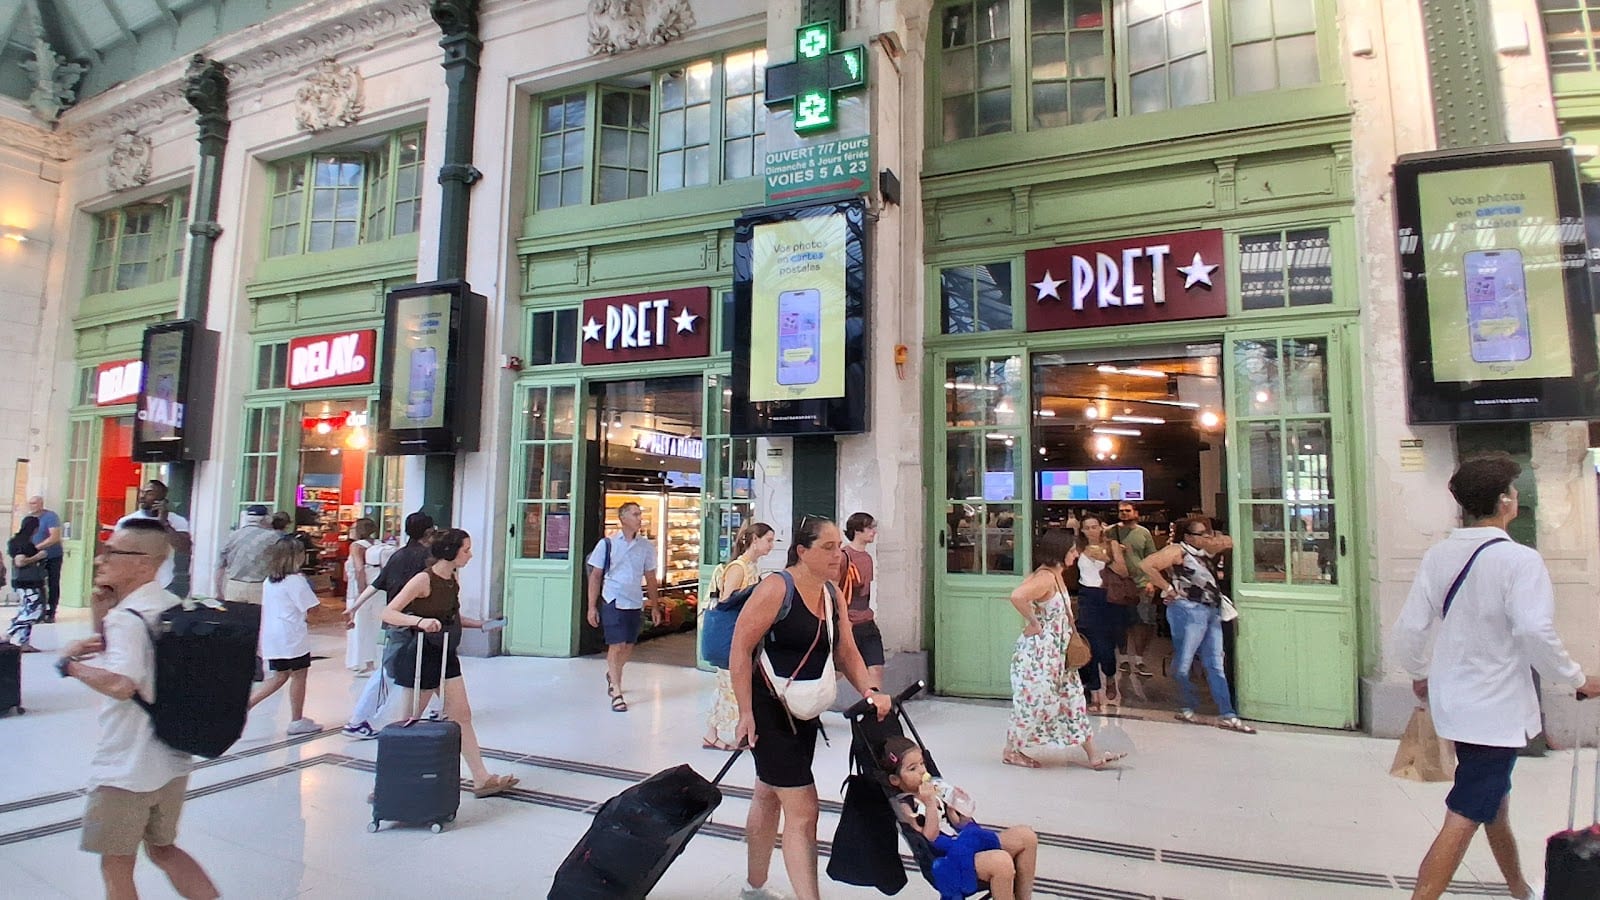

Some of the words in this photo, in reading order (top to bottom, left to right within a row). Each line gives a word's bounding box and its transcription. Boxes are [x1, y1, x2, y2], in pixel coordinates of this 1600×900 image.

[766, 146, 815, 164] OUVERT
[818, 143, 836, 155] 7/7
[838, 138, 869, 154] jours
[766, 161, 807, 175] Dimanche
[809, 159, 815, 167] &
[818, 156, 842, 166] Jours
[844, 150, 869, 161] fériés
[768, 169, 814, 187] VOIES
[819, 167, 828, 178] 5
[833, 164, 844, 176] A
[849, 160, 867, 174] 23
[1448, 197, 1473, 205] Vos
[1477, 193, 1526, 205] photos
[1456, 210, 1471, 218] en
[1476, 206, 1521, 217] cartes
[1461, 220, 1518, 233] poales
[774, 244, 790, 253] Vos
[793, 240, 829, 252] photos
[790, 251, 825, 262] cartes
[779, 263, 821, 275] postales
[1072, 244, 1170, 311] PRET
[606, 299, 669, 350] PRET
[291, 333, 359, 385] RELAY
